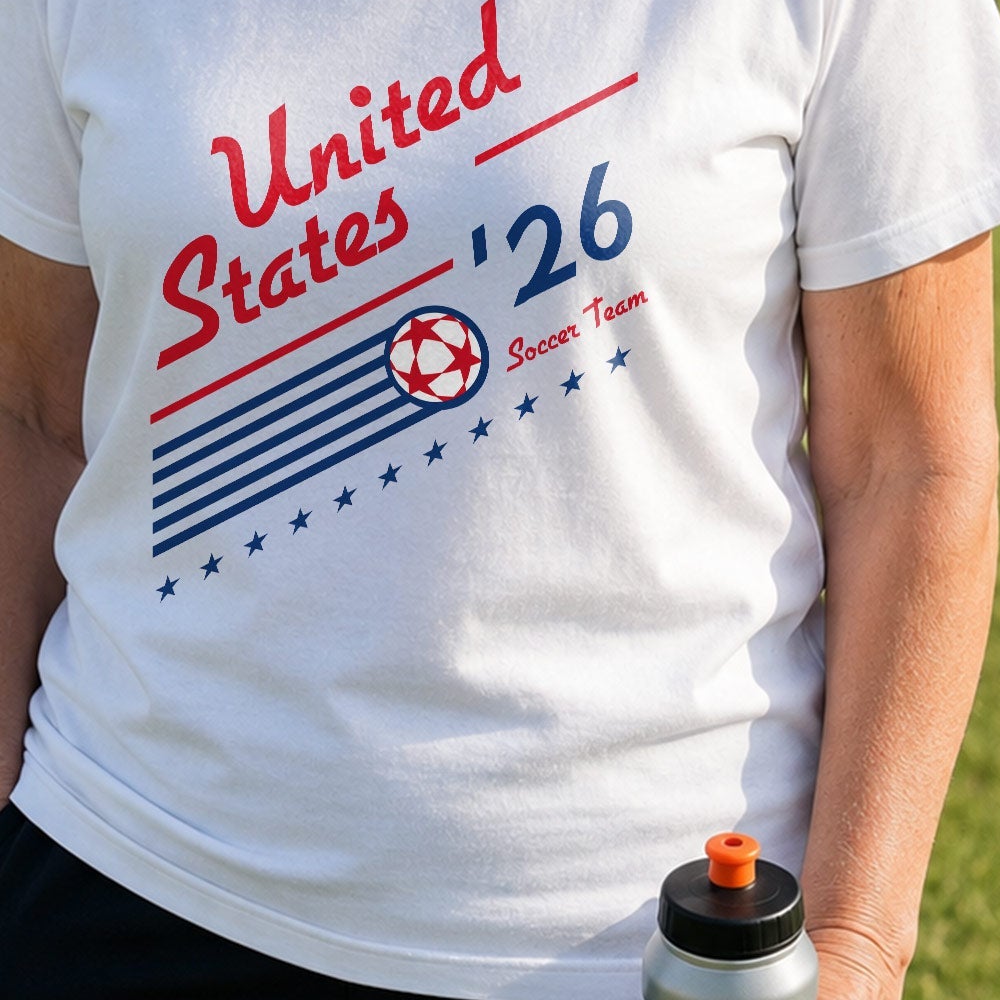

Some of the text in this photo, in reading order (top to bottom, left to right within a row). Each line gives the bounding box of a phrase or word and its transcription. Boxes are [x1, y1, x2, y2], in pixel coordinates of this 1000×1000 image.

[157, 187, 409, 370] States
[471, 161, 633, 308] '26
[506, 290, 649, 372] Soccer Team
